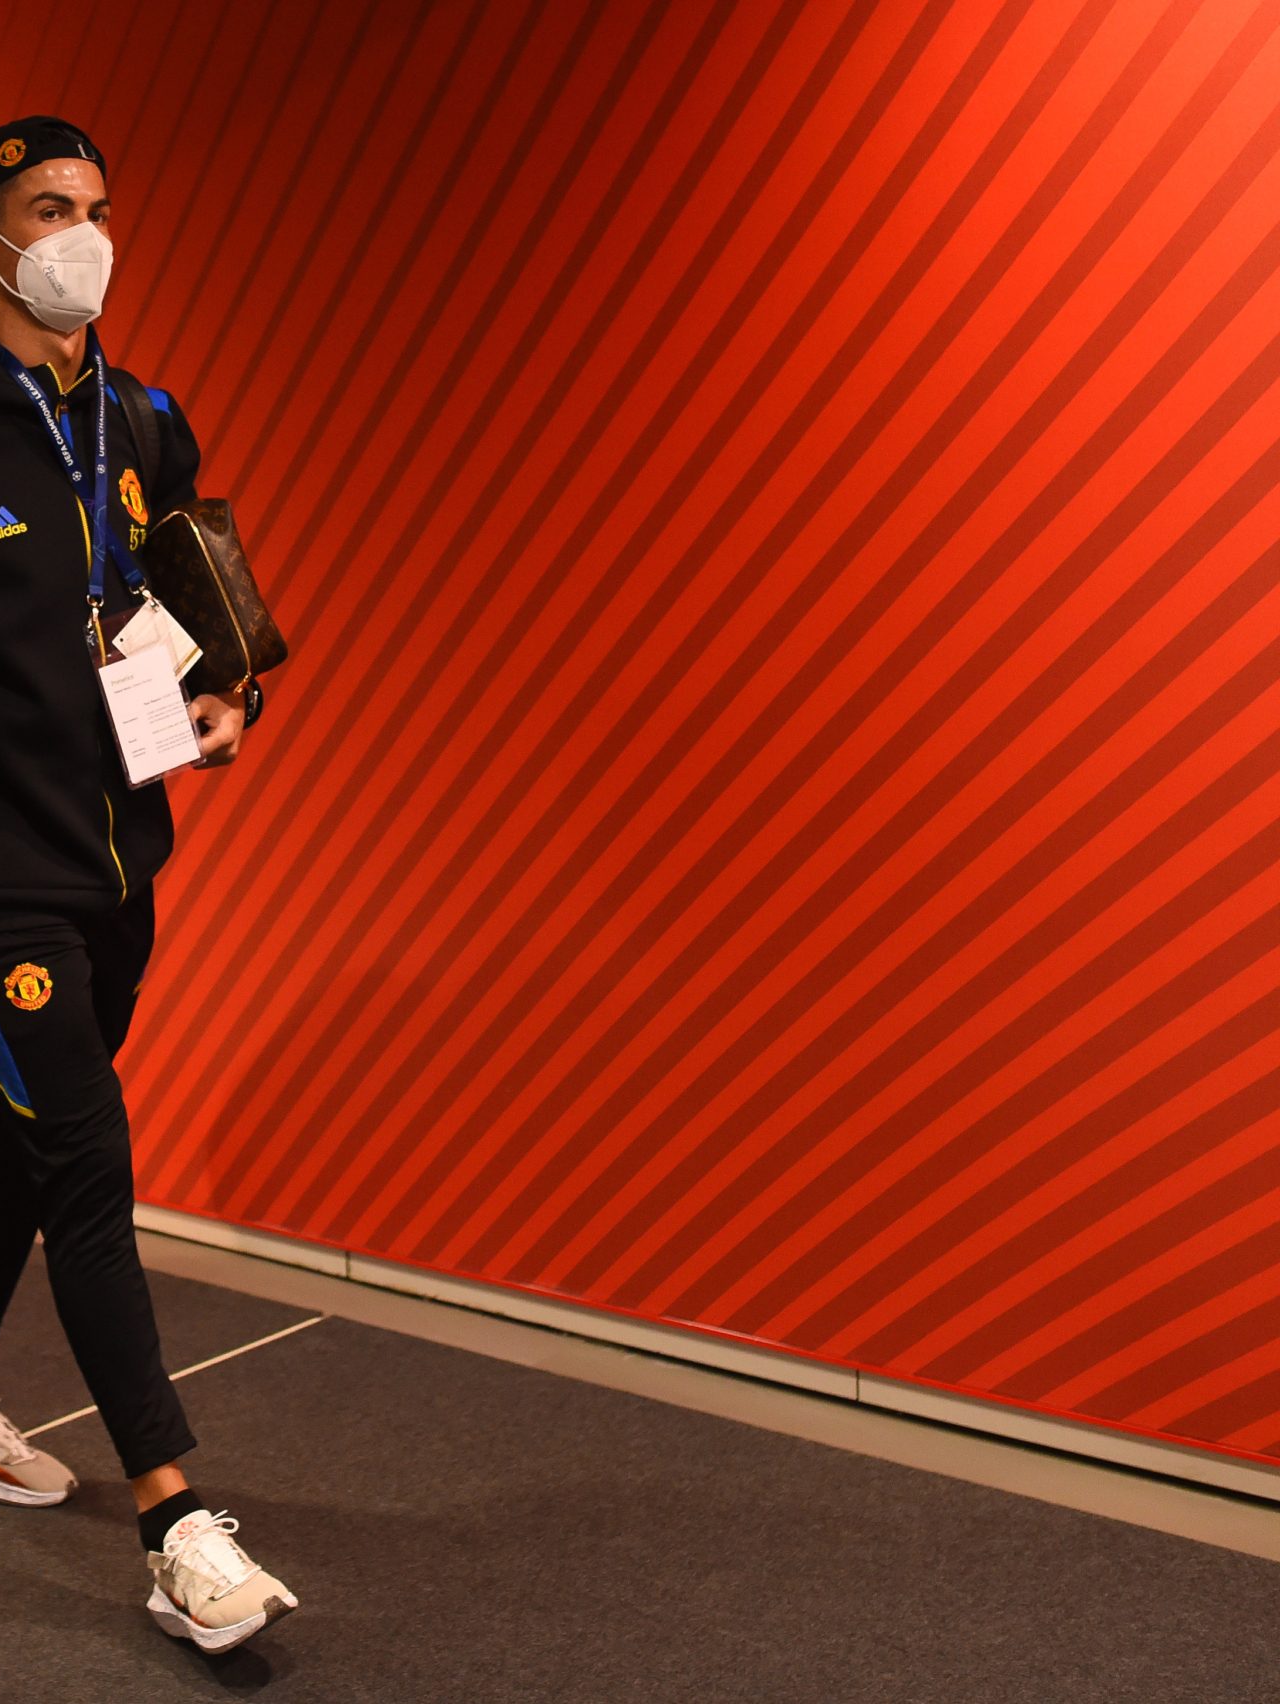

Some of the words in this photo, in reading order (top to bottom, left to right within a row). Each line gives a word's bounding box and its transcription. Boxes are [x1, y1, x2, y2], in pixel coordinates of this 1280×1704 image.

[17, 371, 42, 400] LEAGUE
[38, 399, 64, 445] CHAMPIONS
[60, 444, 74, 467] UEFA
